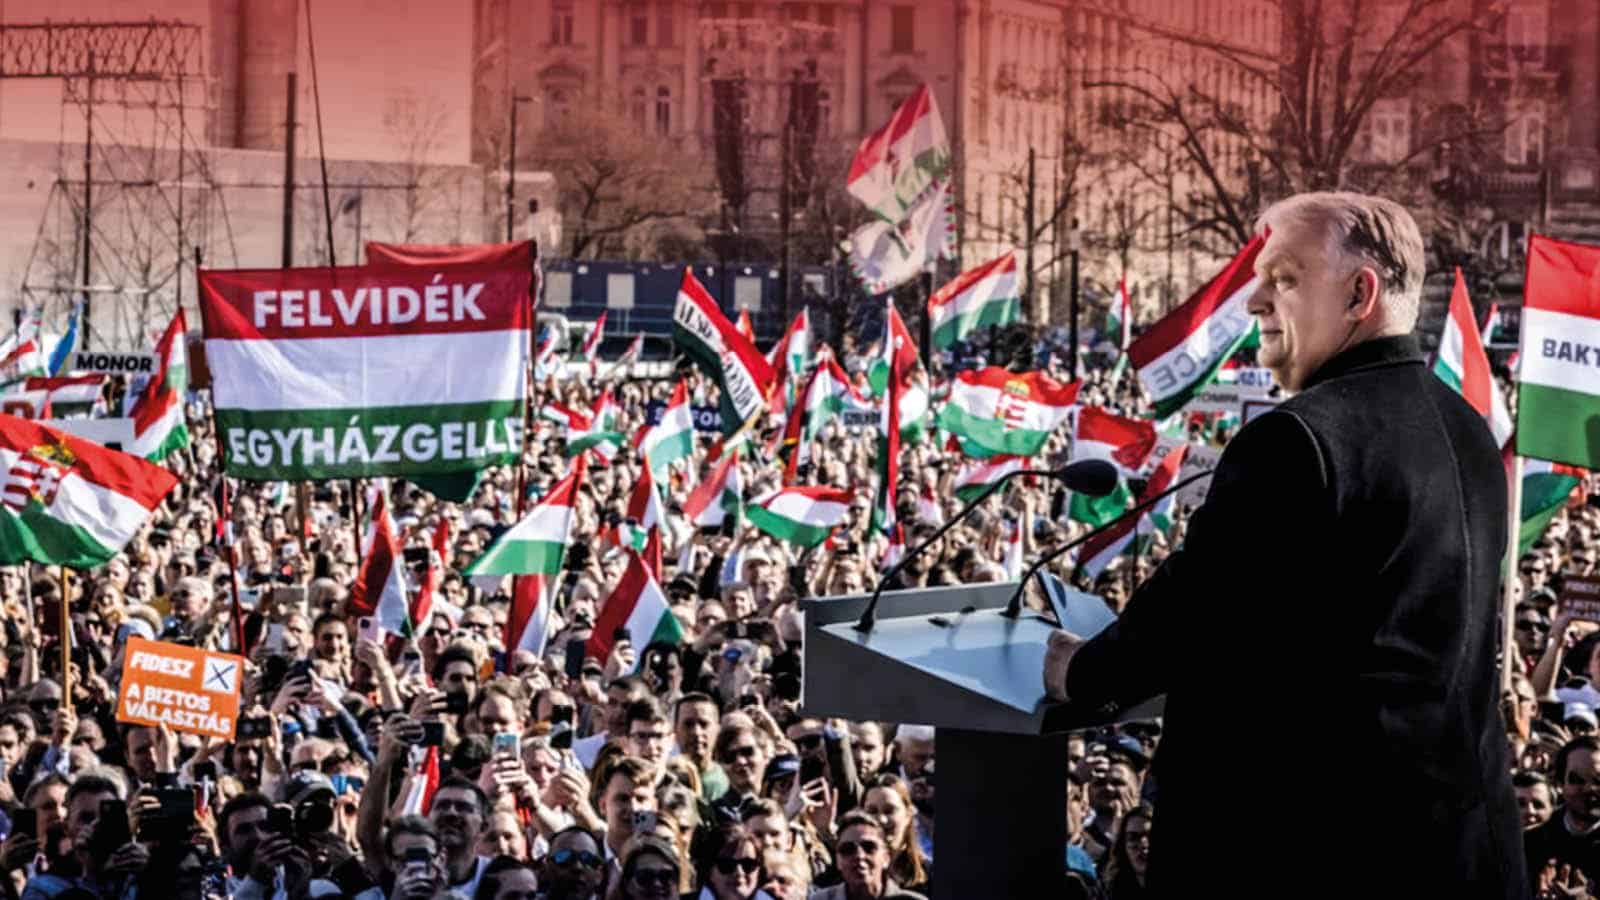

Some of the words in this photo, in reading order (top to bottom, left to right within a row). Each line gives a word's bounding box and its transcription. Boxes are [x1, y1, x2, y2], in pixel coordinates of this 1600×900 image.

[253, 274, 485, 328] FELVIDÉK
[76, 354, 153, 372] MONOR
[227, 415, 524, 467] EGYHÁZGELLE
[130, 651, 195, 679] FIDESZ
[126, 683, 140, 700] A
[144, 684, 210, 711] BIZTOS
[125, 698, 231, 734] VÁLASZTÁS
